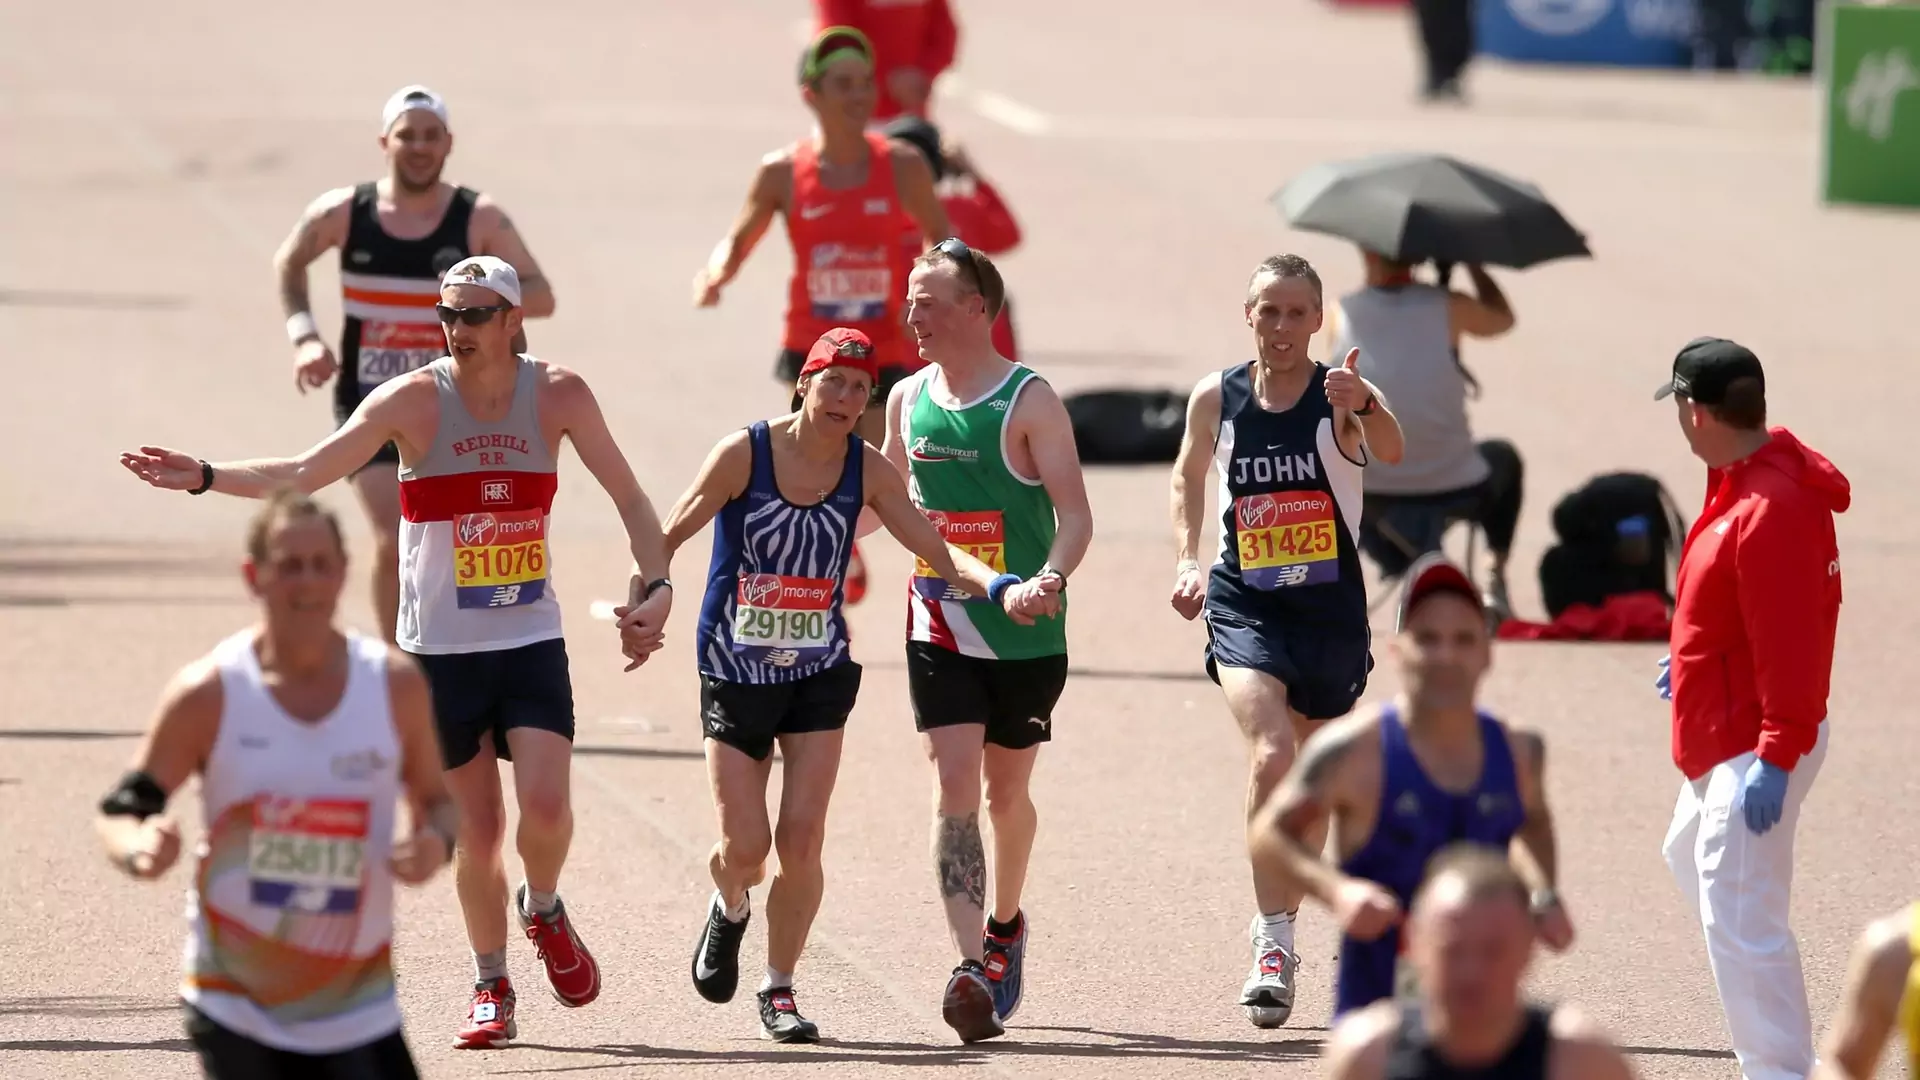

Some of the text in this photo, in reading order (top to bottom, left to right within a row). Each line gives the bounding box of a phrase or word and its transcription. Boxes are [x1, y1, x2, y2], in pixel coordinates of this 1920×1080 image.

[452, 434, 529, 456] REDHILL
[927, 443, 979, 458] Beechmount
[1235, 453, 1316, 484] JOHN
[1242, 496, 1327, 526] Virgin money
[460, 514, 540, 544] Virgin money
[950, 521, 997, 534] money
[1242, 523, 1332, 561] 31425
[458, 543, 543, 579] 31076
[745, 574, 827, 604] Virgin money
[738, 608, 823, 640] 29190
